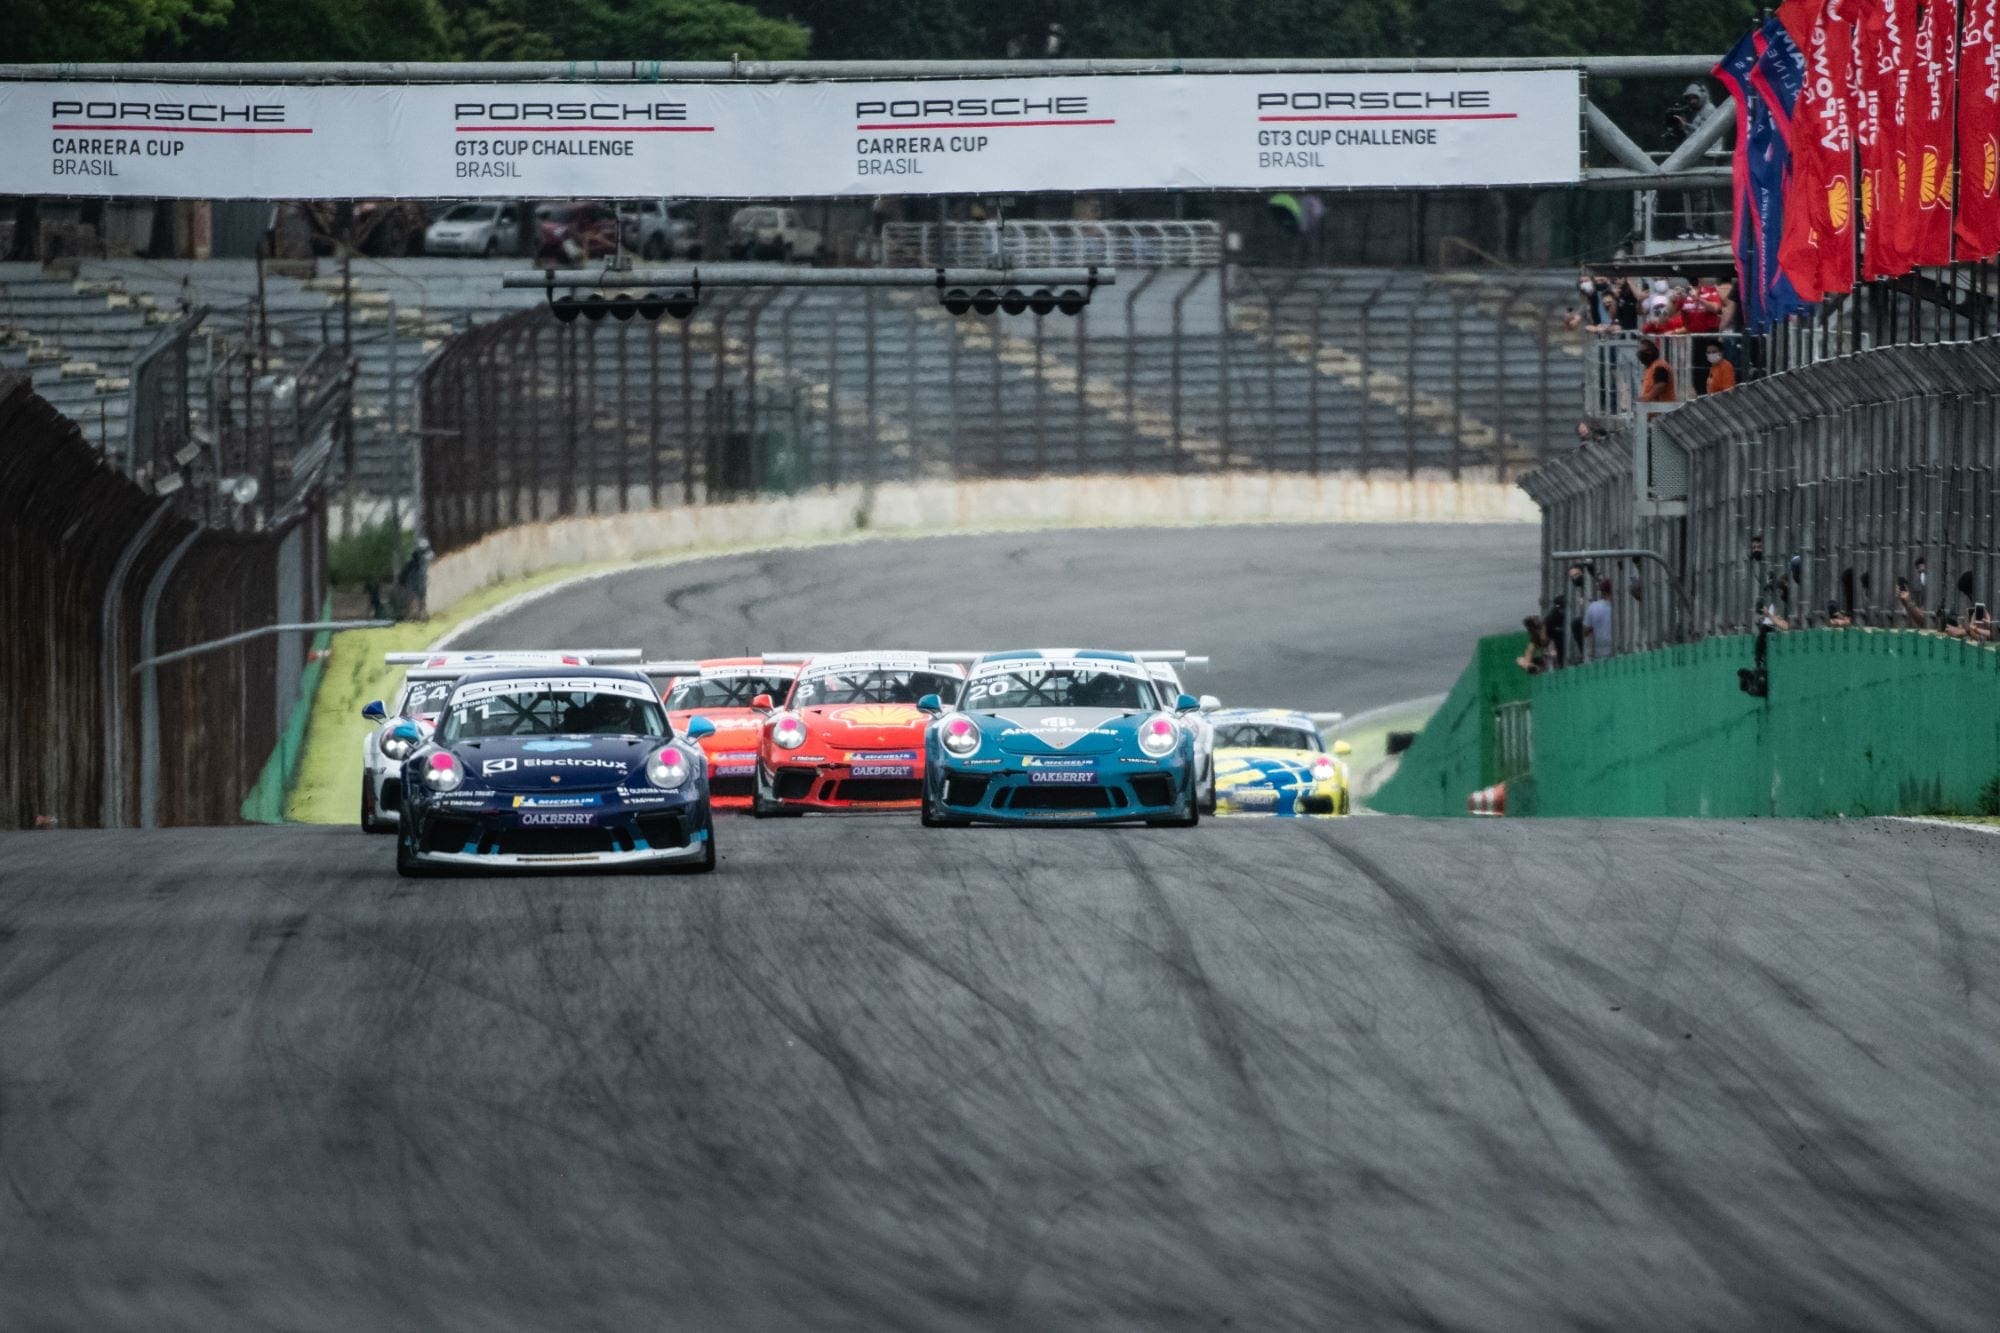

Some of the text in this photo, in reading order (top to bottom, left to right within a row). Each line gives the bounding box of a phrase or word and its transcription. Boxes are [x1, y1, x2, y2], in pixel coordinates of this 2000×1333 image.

[856, 97, 1088, 118] PORSCHE
[1258, 91, 1490, 110] PORSCHE
[53, 102, 285, 122] PORSCHE
[455, 103, 687, 120] PORSCHE
[857, 136, 988, 154] CARRERA CUP
[1258, 129, 1437, 146] GT3 CUP CHALLENGE
[53, 138, 184, 156] CARRERA CUP
[455, 140, 634, 156] GT3 CUP CHALLENGE
[53, 159, 118, 176] BRASIL
[857, 158, 922, 175] BRASIL
[1258, 152, 1325, 168] BRASIL
[456, 161, 521, 178] BRASIL
[980, 661, 1137, 674] PORSCHE
[409, 686, 449, 706] 54
[462, 681, 644, 697] PORSCHE
[796, 685, 815, 699] 8
[969, 682, 1009, 701] 20
[453, 704, 490, 725] 11
[523, 758, 628, 770] Electrolux
[852, 767, 910, 776] OAKBERRY
[1032, 772, 1094, 783] OAKBERRY
[537, 797, 594, 805] MICHELIN
[522, 813, 594, 825] OAKBERRY
